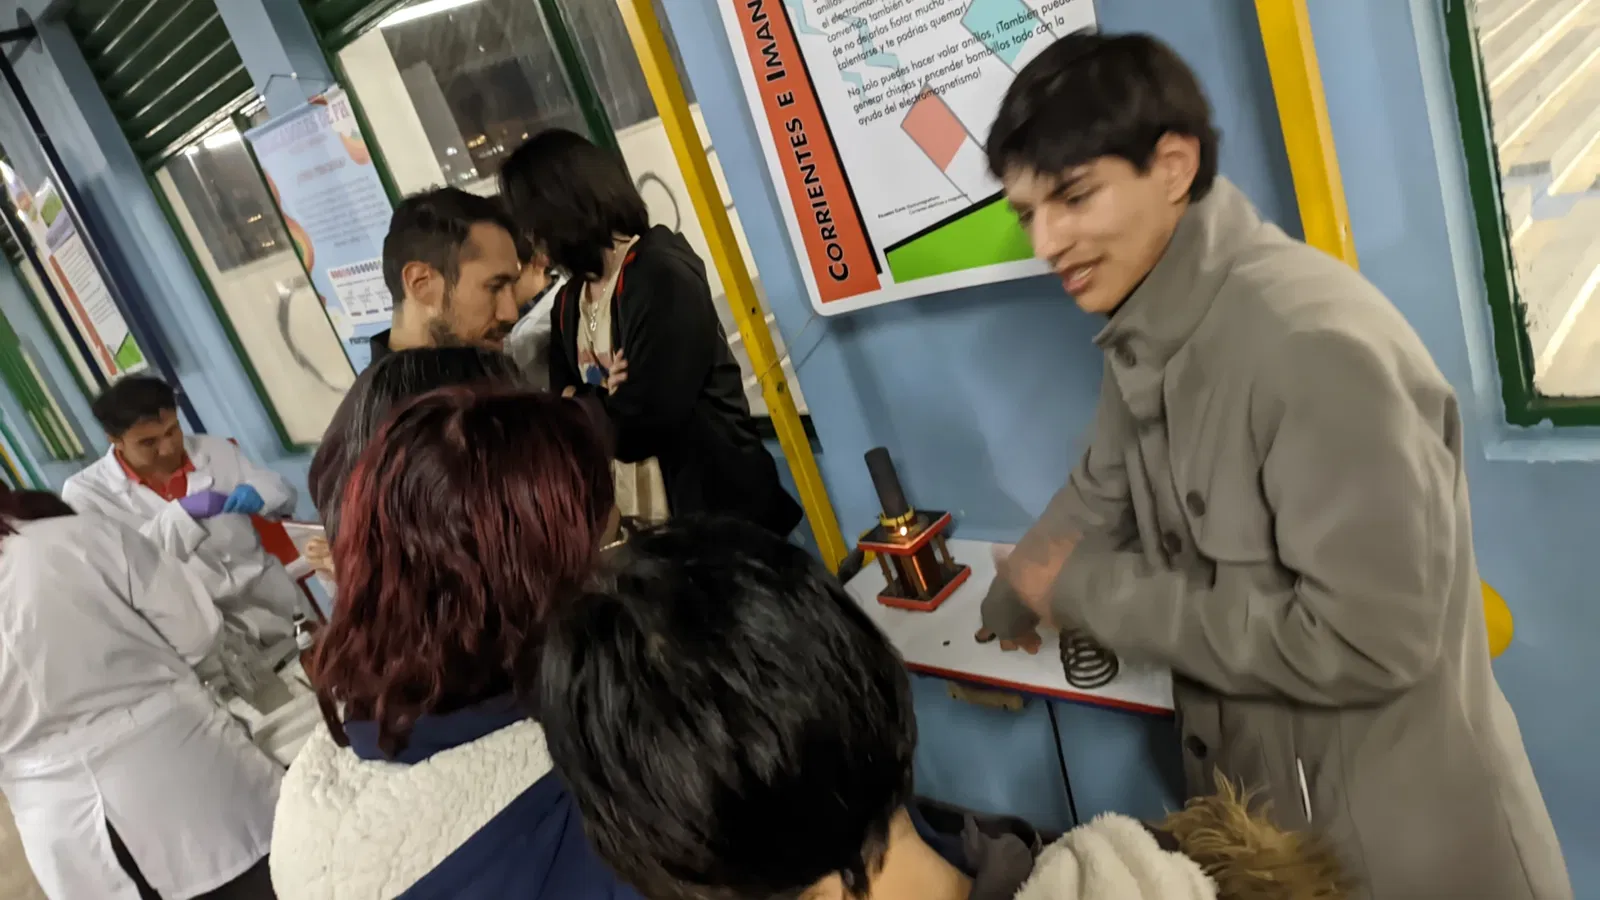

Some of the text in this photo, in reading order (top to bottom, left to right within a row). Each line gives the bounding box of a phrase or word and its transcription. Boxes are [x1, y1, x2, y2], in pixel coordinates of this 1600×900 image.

[821, 16, 830, 29] el
[827, 17, 868, 43] convertido
[832, 46, 843, 57] de
[844, 42, 856, 52] no
[857, 25, 889, 44] dejarlos
[915, 0, 945, 18] mucho
[837, 47, 878, 71] calentarse
[879, 44, 885, 54] y
[886, 38, 896, 49] te
[847, 86, 860, 98] No
[862, 79, 879, 93] solo
[880, 65, 911, 86] puedes
[911, 55, 935, 70] hacer
[937, 43, 960, 59] volar
[853, 15, 1065, 114] generar chispas y encender bombillos todo con la
[777, 91, 795, 108] E
[858, 66, 982, 126] ayuda del electromagnetismo!
[786, 116, 849, 282] CORRIENTES
